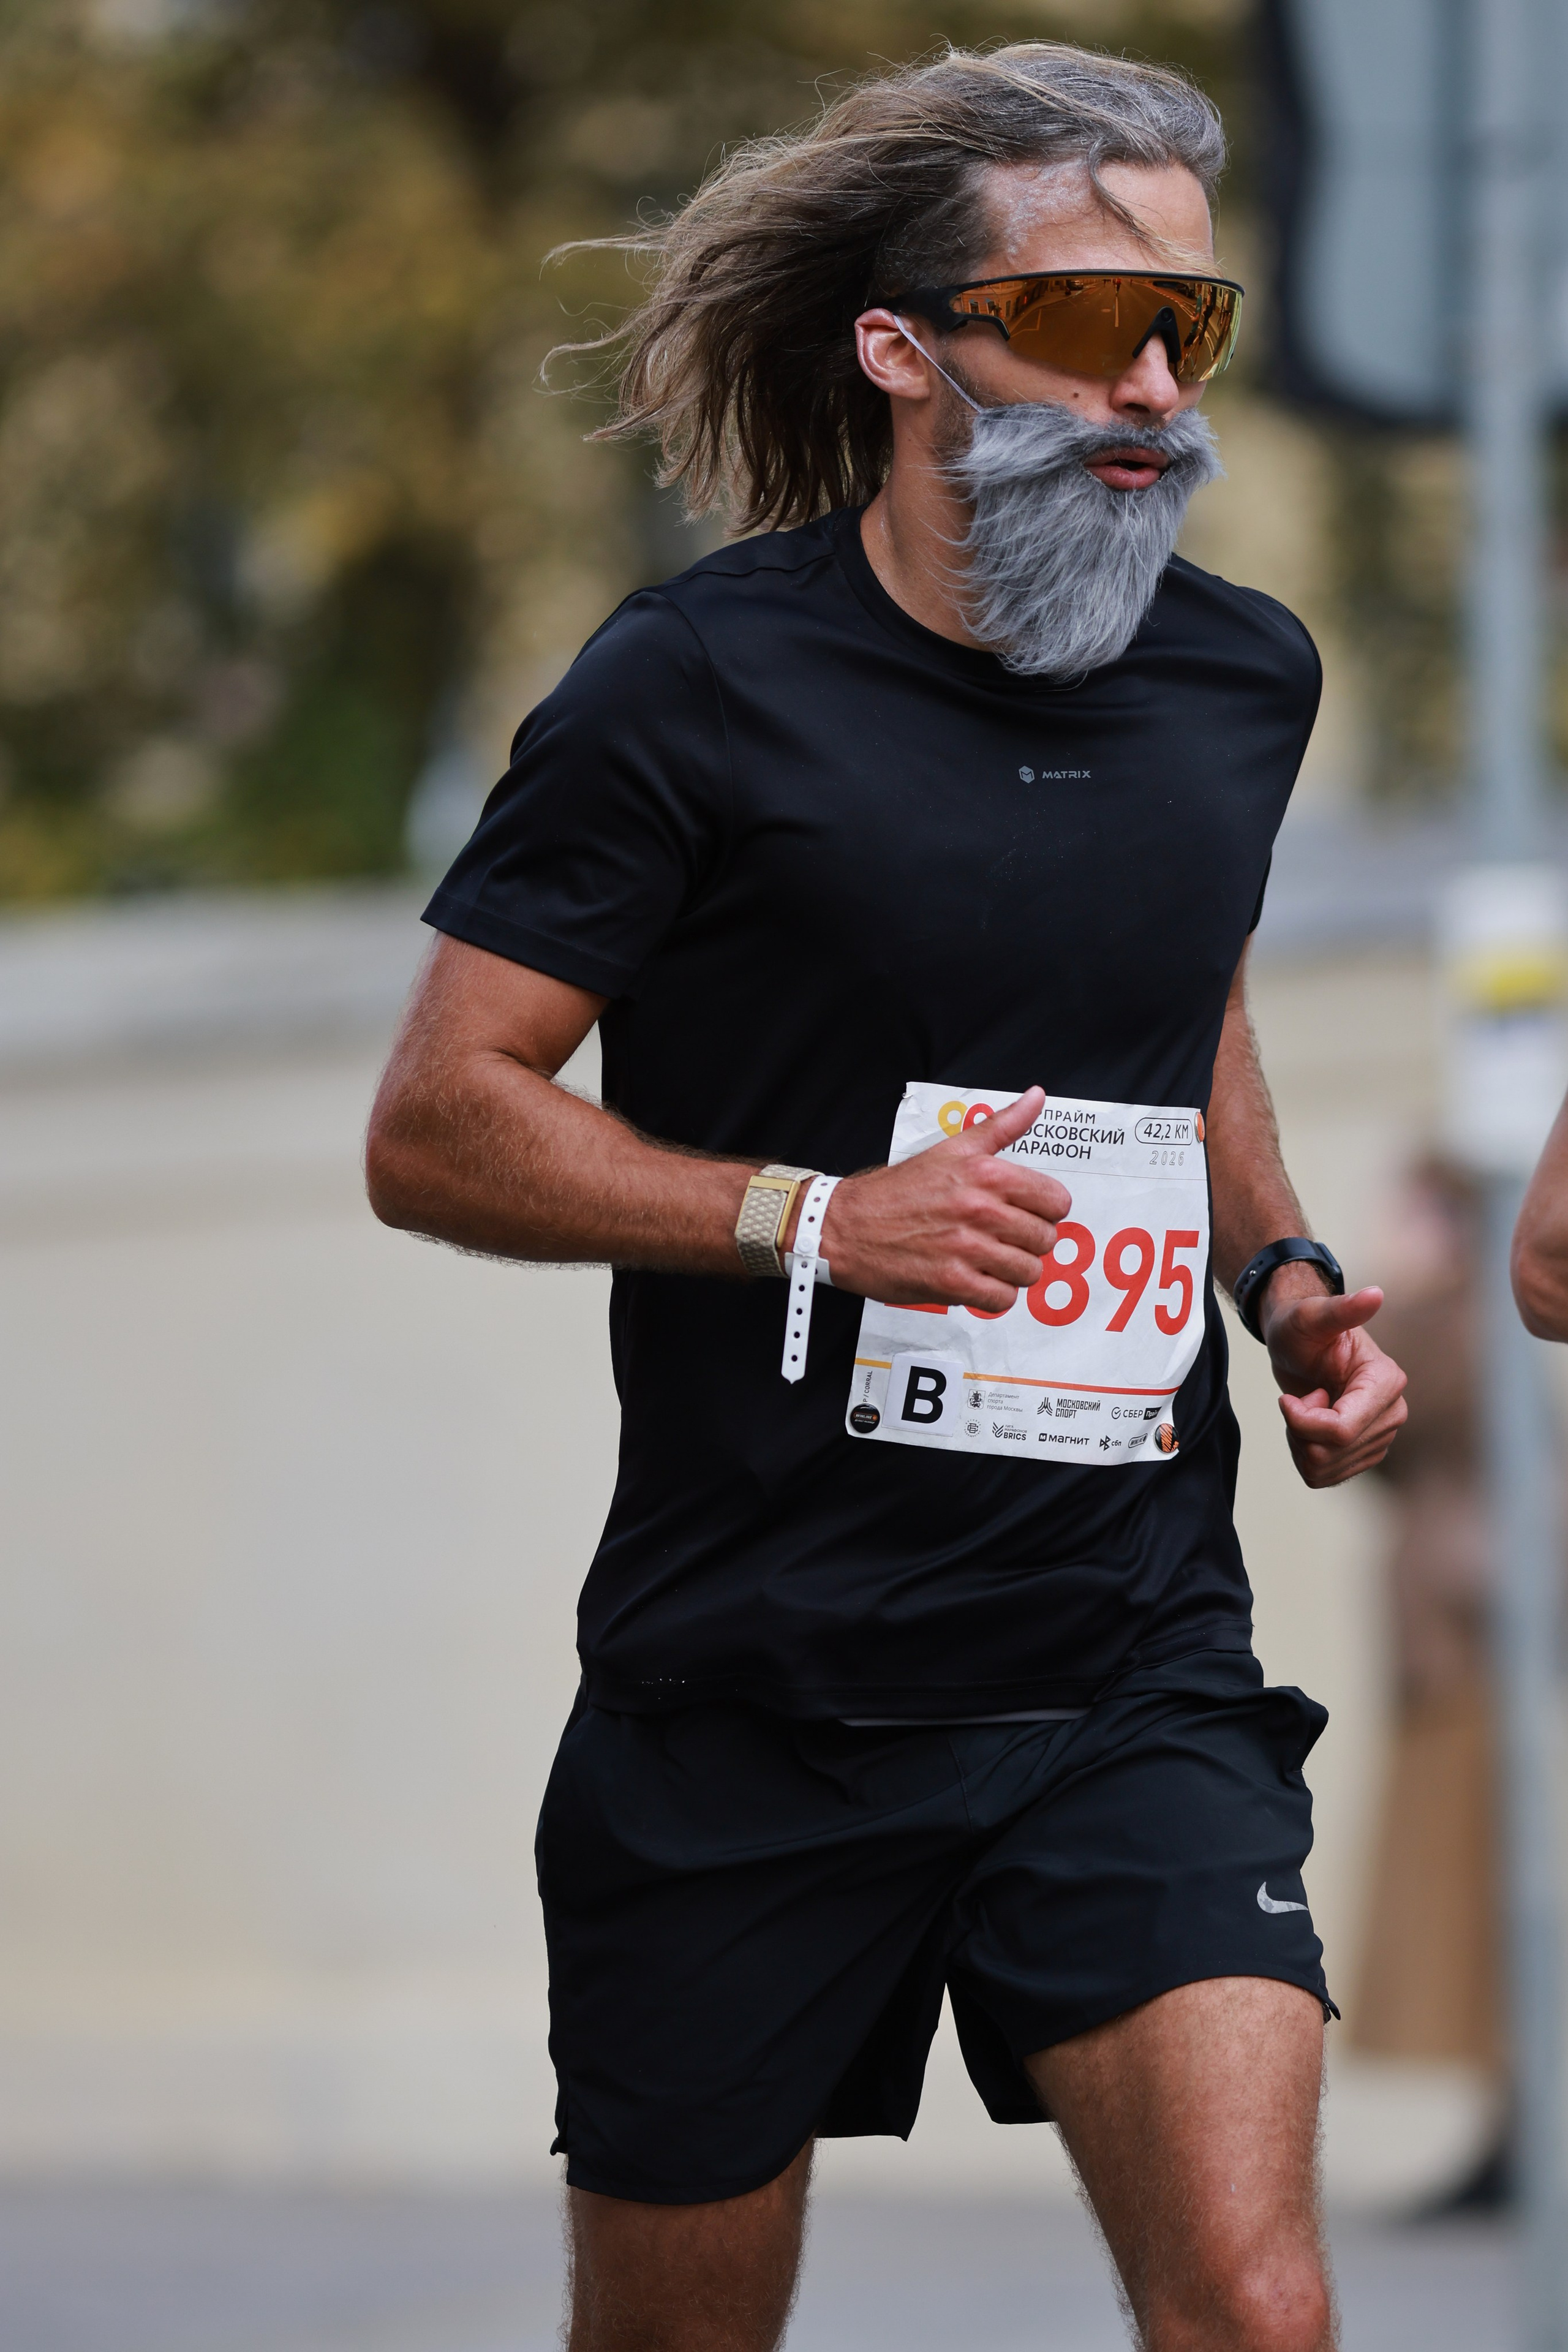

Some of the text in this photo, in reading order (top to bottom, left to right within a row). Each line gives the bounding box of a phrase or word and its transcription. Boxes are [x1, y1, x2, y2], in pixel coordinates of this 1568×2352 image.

[1044, 1109, 1096, 1125] ПРАЙМ
[1023, 1124, 1125, 1145] СКОВСКИЙ
[1144, 1123, 1189, 1140] 42,2 КМ
[1149, 1150, 1185, 1166] 2026
[884, 1221, 1199, 1336] 895
[864, 1371, 873, 1393] CORRAL
[900, 1365, 948, 1424] B
[1057, 1398, 1101, 1411] МОСКОВСКИЙ
[1055, 1408, 1077, 1419] СПОРТ
[1123, 1409, 1144, 1418] СБЕР
[1003, 1432, 1027, 1441] BRICS
[1049, 1434, 1090, 1445] магнит
